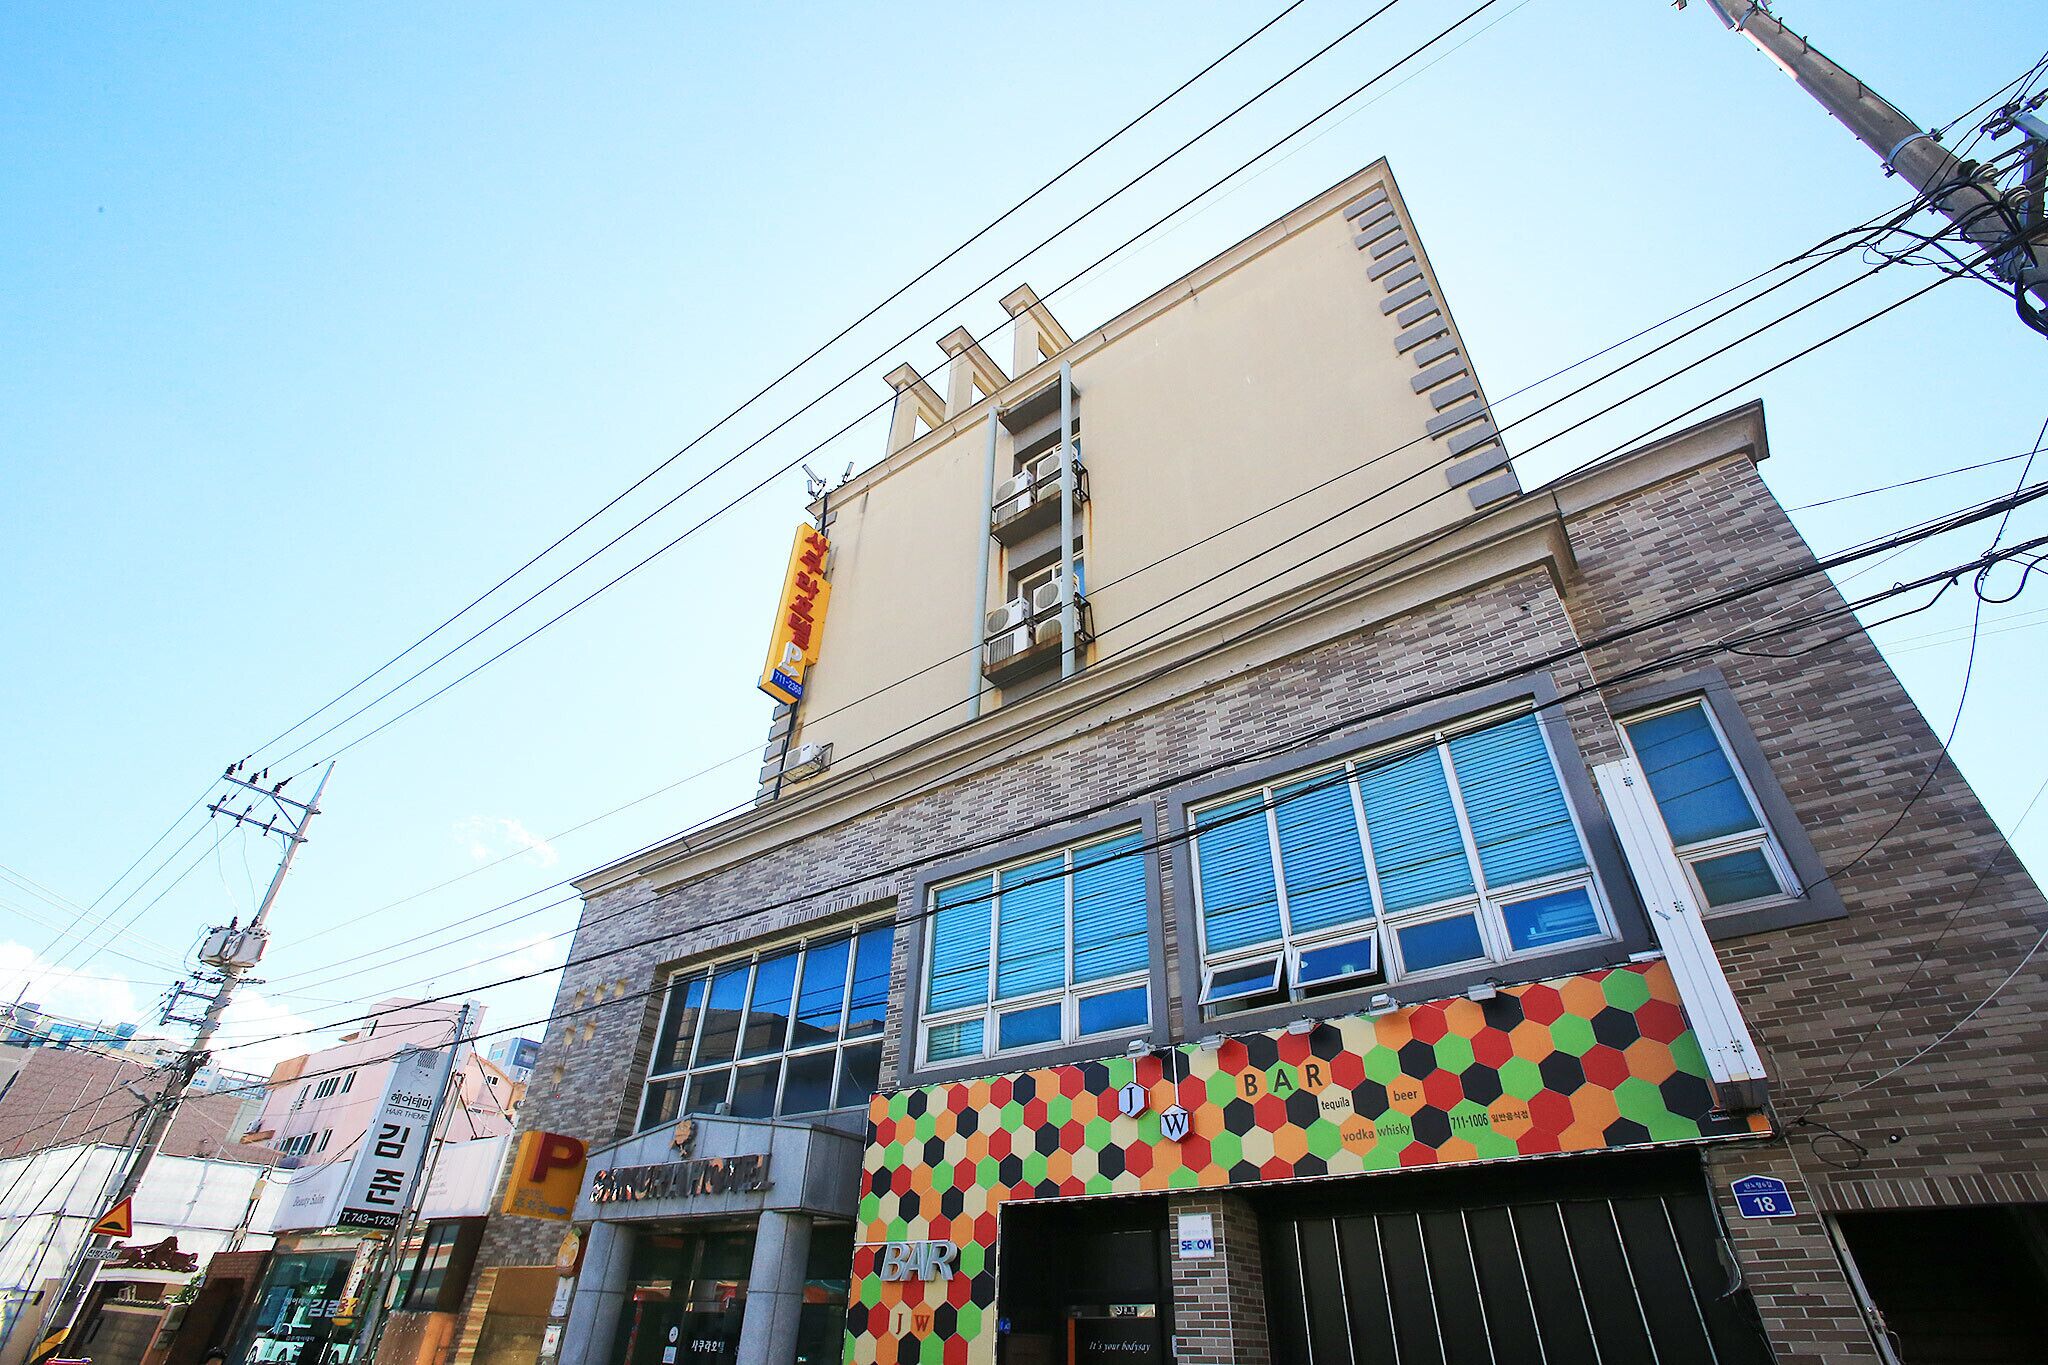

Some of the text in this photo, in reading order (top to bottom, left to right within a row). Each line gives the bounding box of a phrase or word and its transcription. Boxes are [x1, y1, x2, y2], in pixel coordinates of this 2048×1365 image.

[1244, 1063, 1323, 1097] BAR
[391, 1092, 433, 1109] 헤어테마
[1321, 1097, 1350, 1111] tequila
[1393, 1090, 1418, 1102] beer
[385, 1108, 429, 1121] HAIR THEME
[1127, 1087, 1188, 1136] J W
[1491, 1110, 1529, 1123] 일반음식점
[1451, 1113, 1489, 1130] 711-1006
[1343, 1123, 1411, 1142] vodka whisky
[530, 1132, 584, 1183] P
[1753, 1196, 1776, 1212] 18
[1181, 1240, 1212, 1250] SECOM
[880, 1240, 958, 1282] BAR
[896, 1313, 931, 1335] J W
[1102, 1343, 1120, 1354] your
